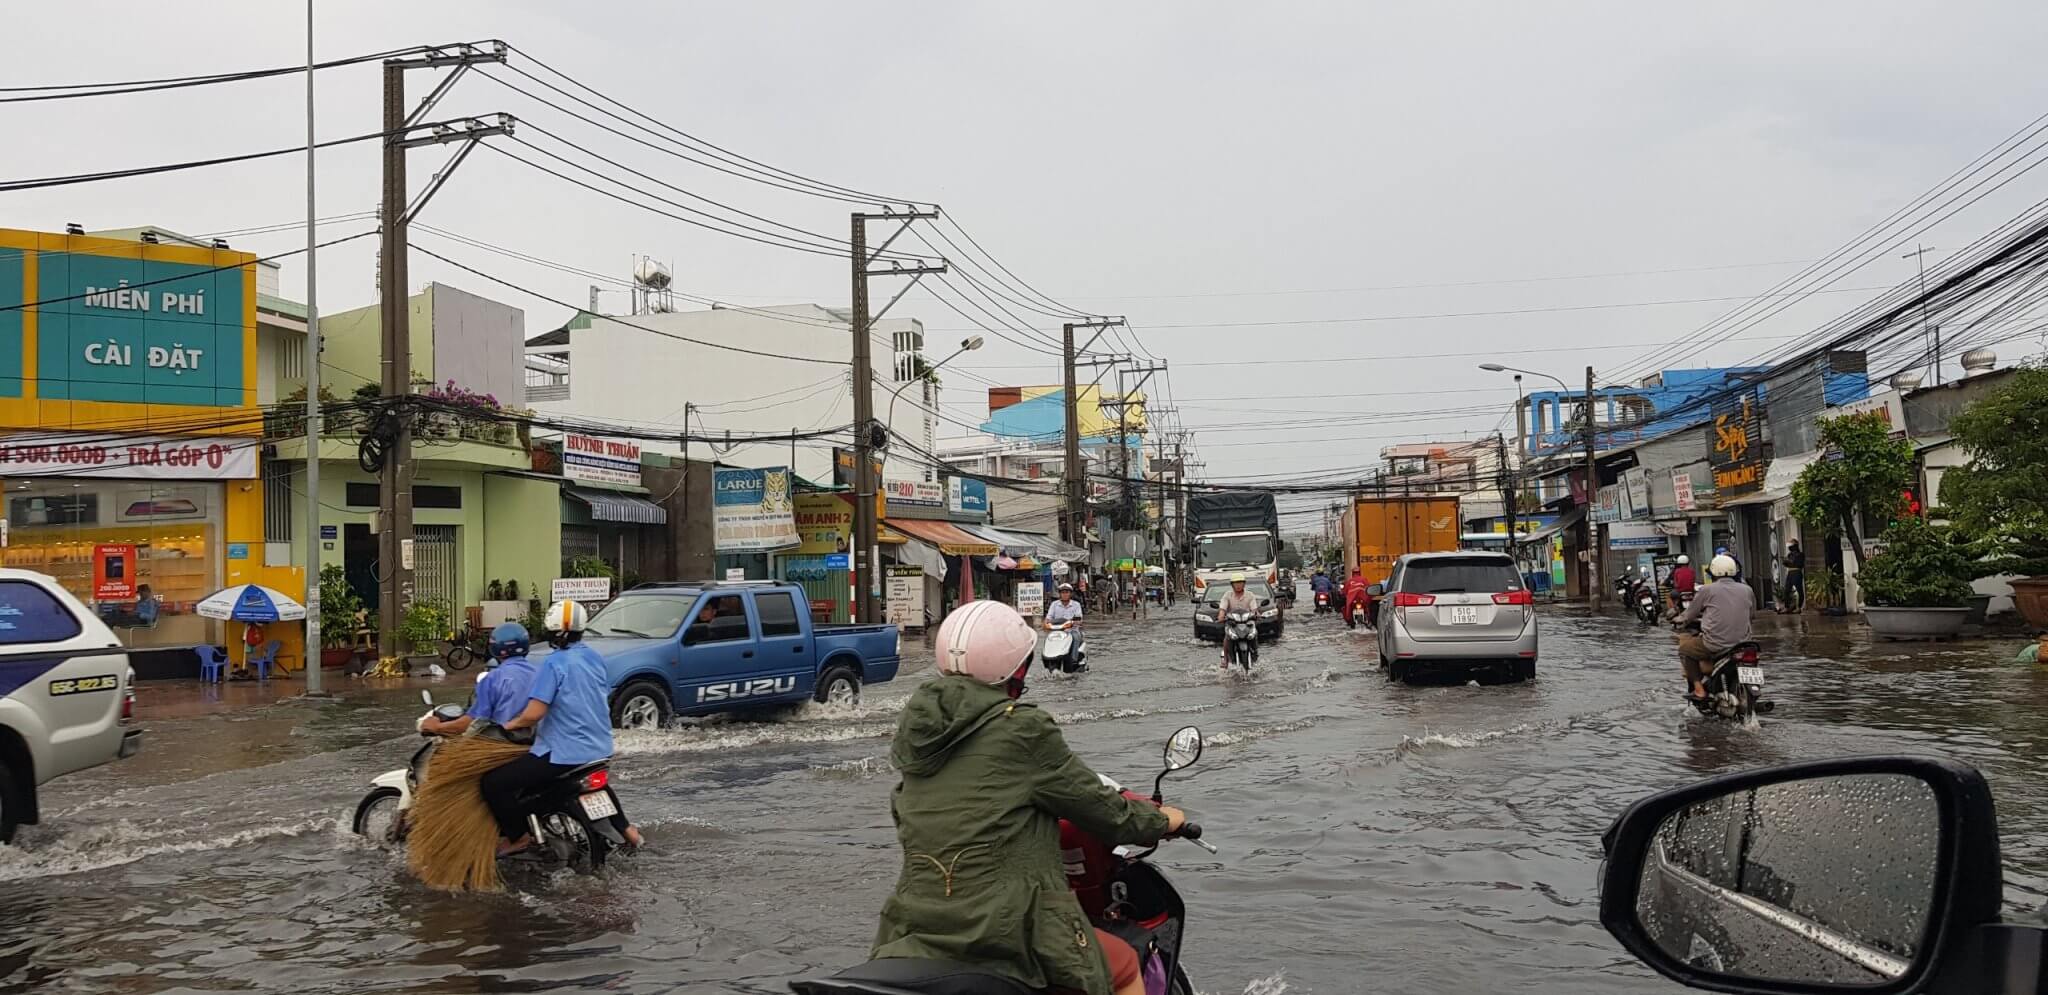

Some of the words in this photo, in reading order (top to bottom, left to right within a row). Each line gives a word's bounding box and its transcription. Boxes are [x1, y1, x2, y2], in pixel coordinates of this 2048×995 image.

[85, 279, 149, 311] MIỄN
[161, 288, 204, 315] PHÍ
[84, 338, 131, 366] CÀI
[148, 342, 203, 375] ĐẶT
[166, 444, 200, 468] GÓP
[607, 441, 640, 461] THUẬN
[718, 480, 763, 491] LARUE
[899, 483, 914, 497] 210
[796, 511, 815, 525] ÂM
[816, 512, 840, 524] ANH
[843, 513, 851, 523] 2
[696, 676, 796, 703] ISUZU
